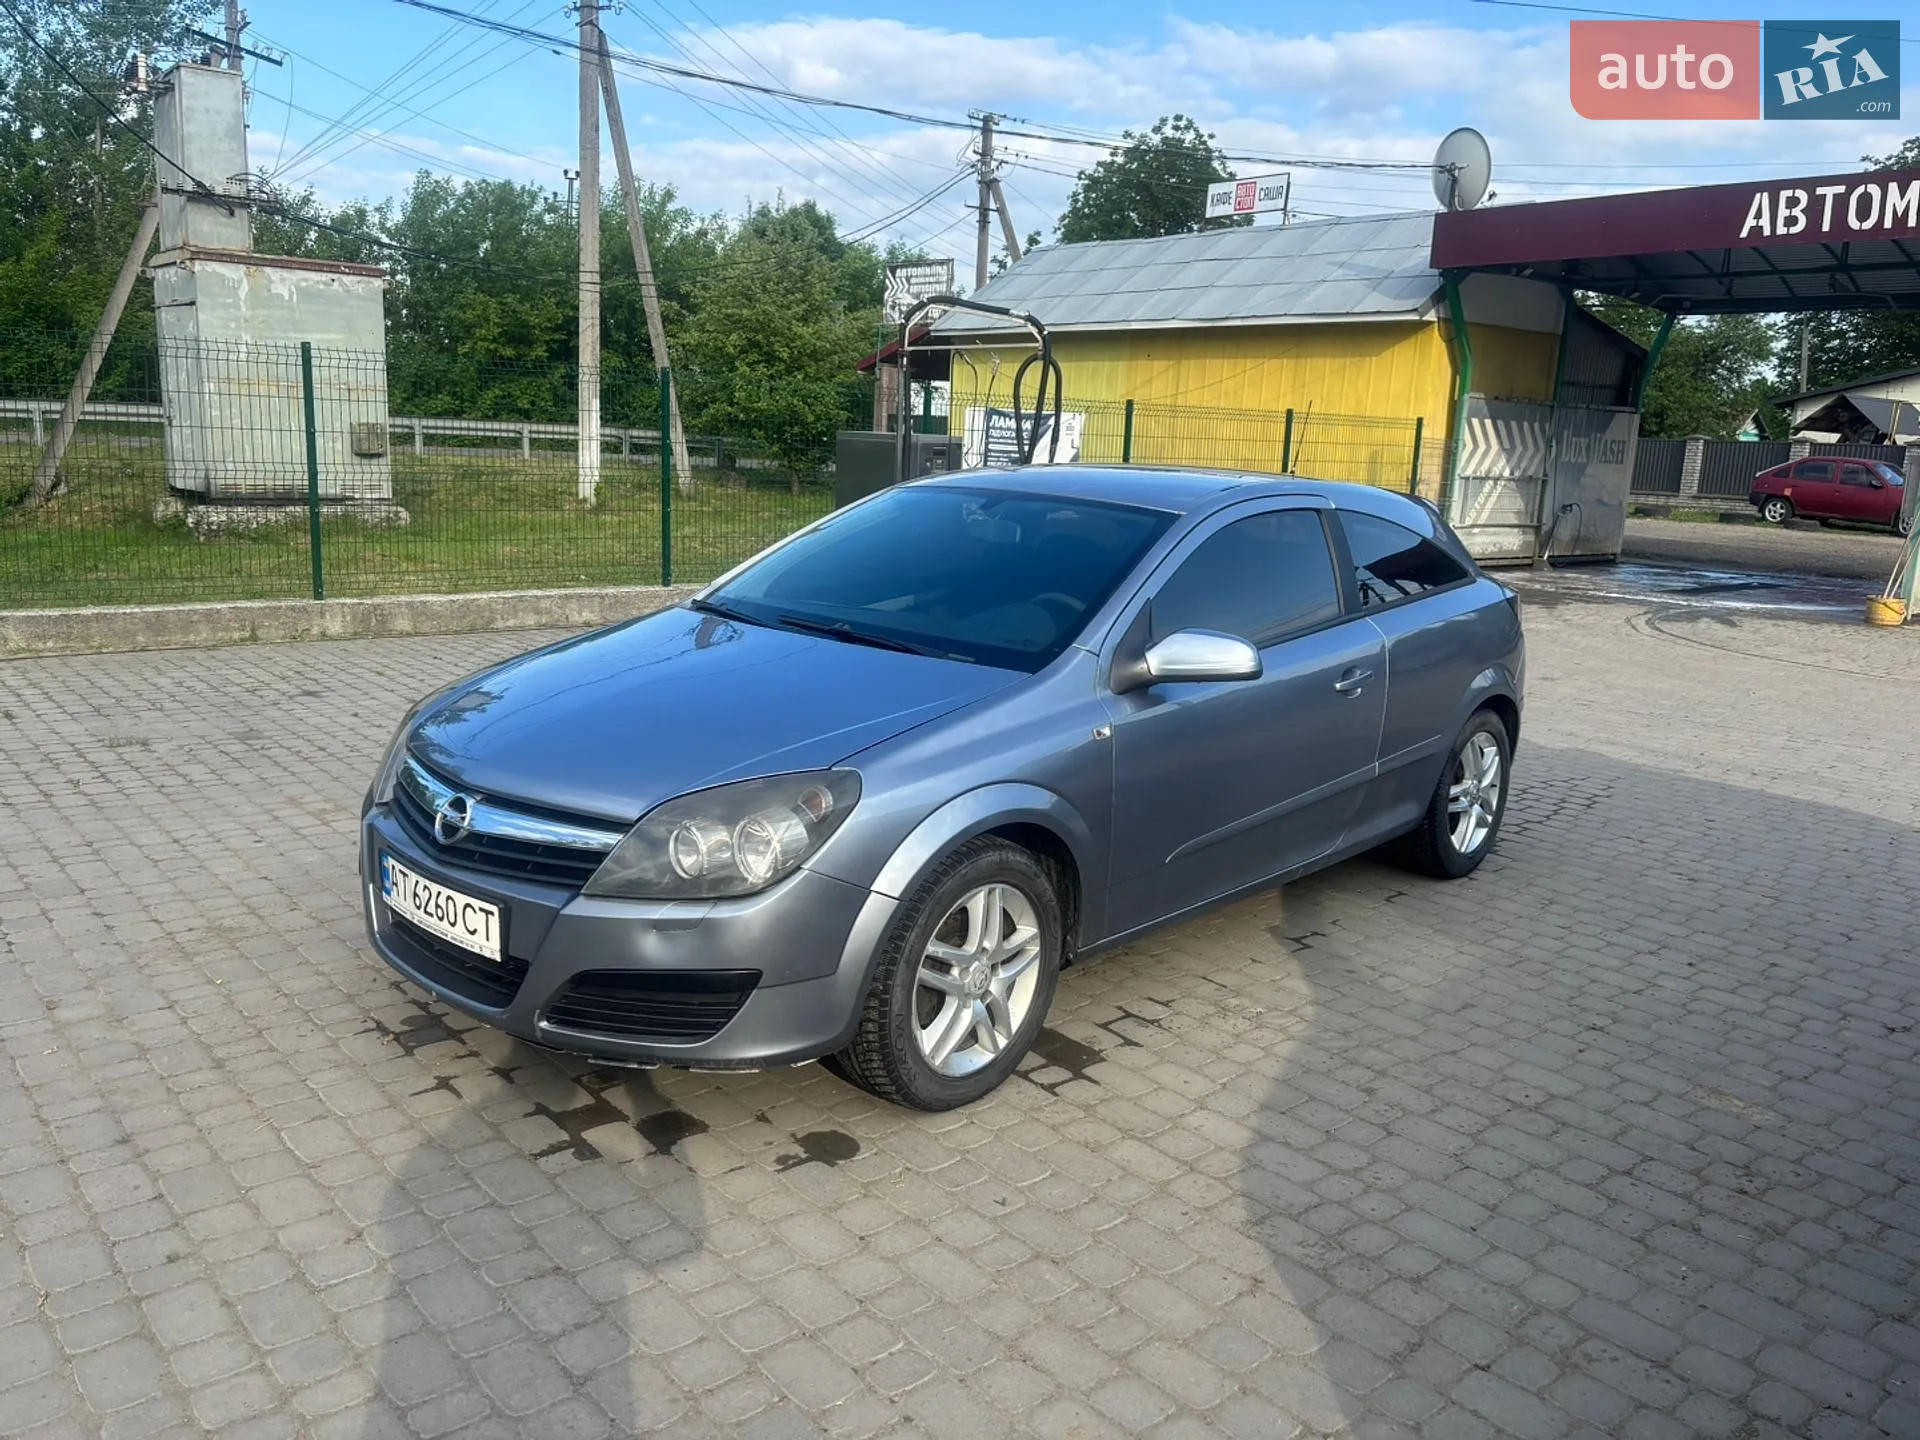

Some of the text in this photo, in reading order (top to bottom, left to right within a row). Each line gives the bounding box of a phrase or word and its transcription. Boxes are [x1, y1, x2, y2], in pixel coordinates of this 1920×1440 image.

[1739, 180, 1920, 238] АВТОМ
[391, 863, 409, 902] AT
[413, 879, 457, 929] 6260
[463, 902, 496, 943] CT
